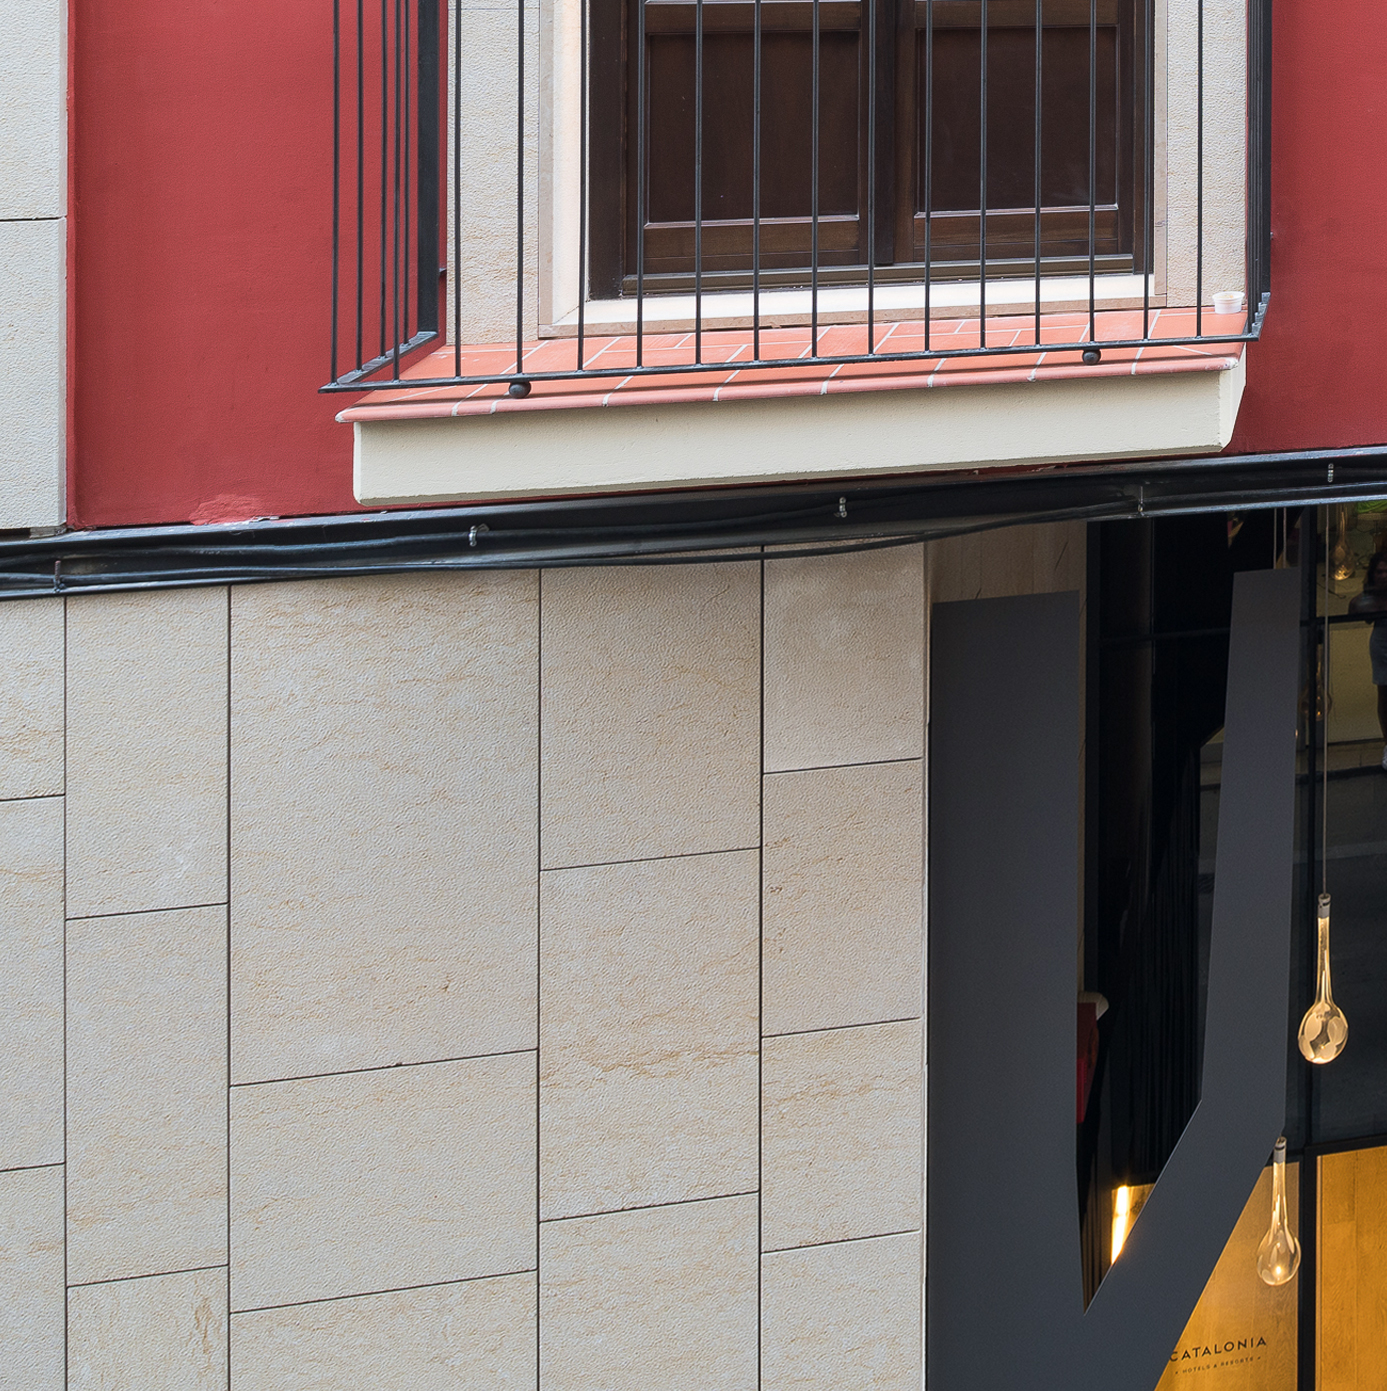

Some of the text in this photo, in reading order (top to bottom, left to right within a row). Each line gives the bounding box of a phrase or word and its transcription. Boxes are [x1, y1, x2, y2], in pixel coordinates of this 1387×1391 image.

[1169, 1336, 1267, 1362] CATALONIA
[1182, 1365, 1210, 1374] HOTELS
[1220, 1356, 1254, 1366] RESORTS
